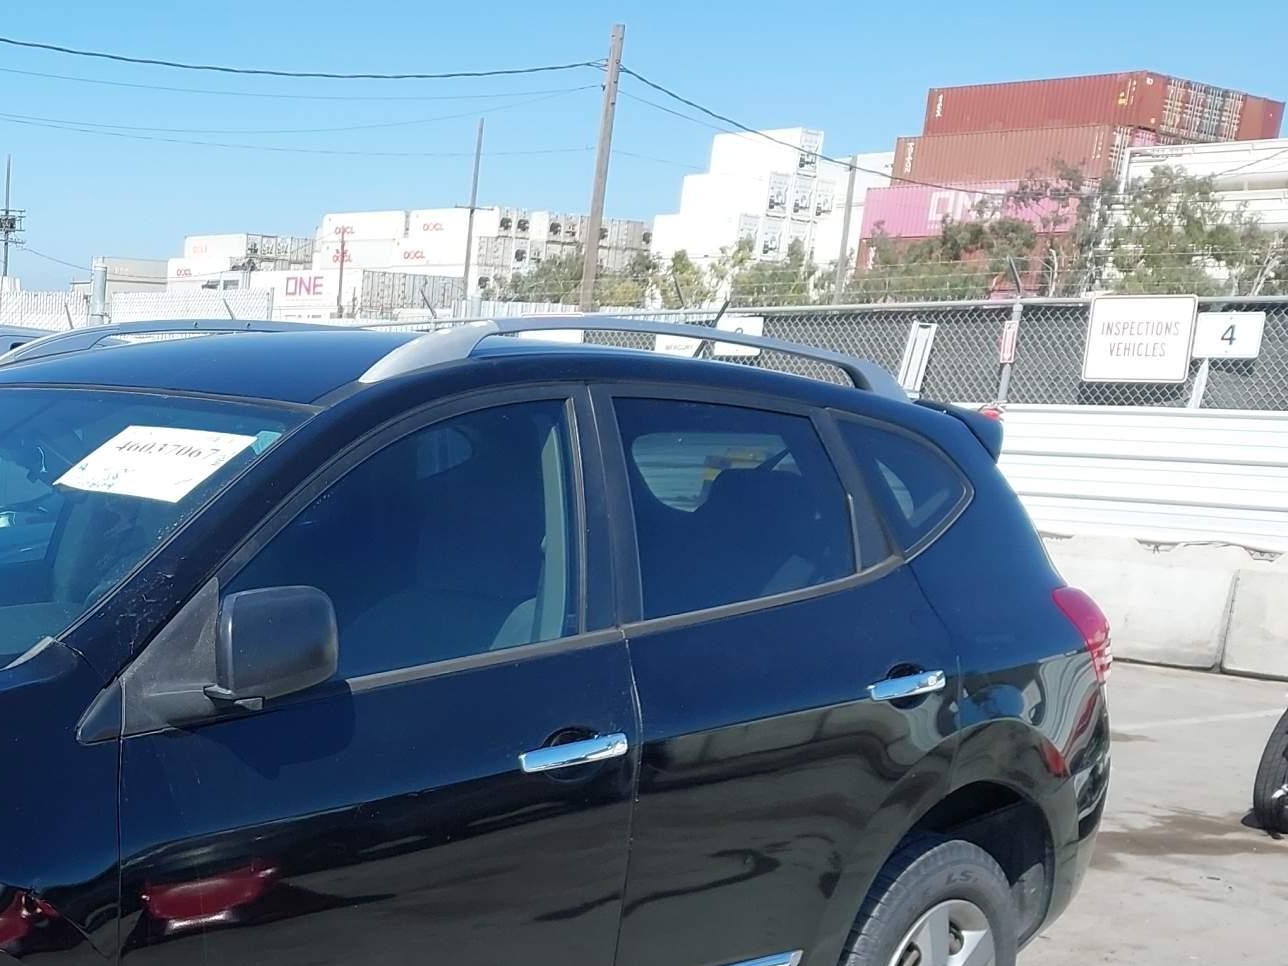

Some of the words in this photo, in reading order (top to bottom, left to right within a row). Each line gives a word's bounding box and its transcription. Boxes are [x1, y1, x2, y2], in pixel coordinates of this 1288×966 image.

[403, 249, 425, 260] OOCL
[285, 275, 324, 296] ONE
[1101, 321, 1181, 337] INSPECTIONS
[1220, 324, 1237, 346] 4
[1109, 342, 1167, 358] VEHICLES
